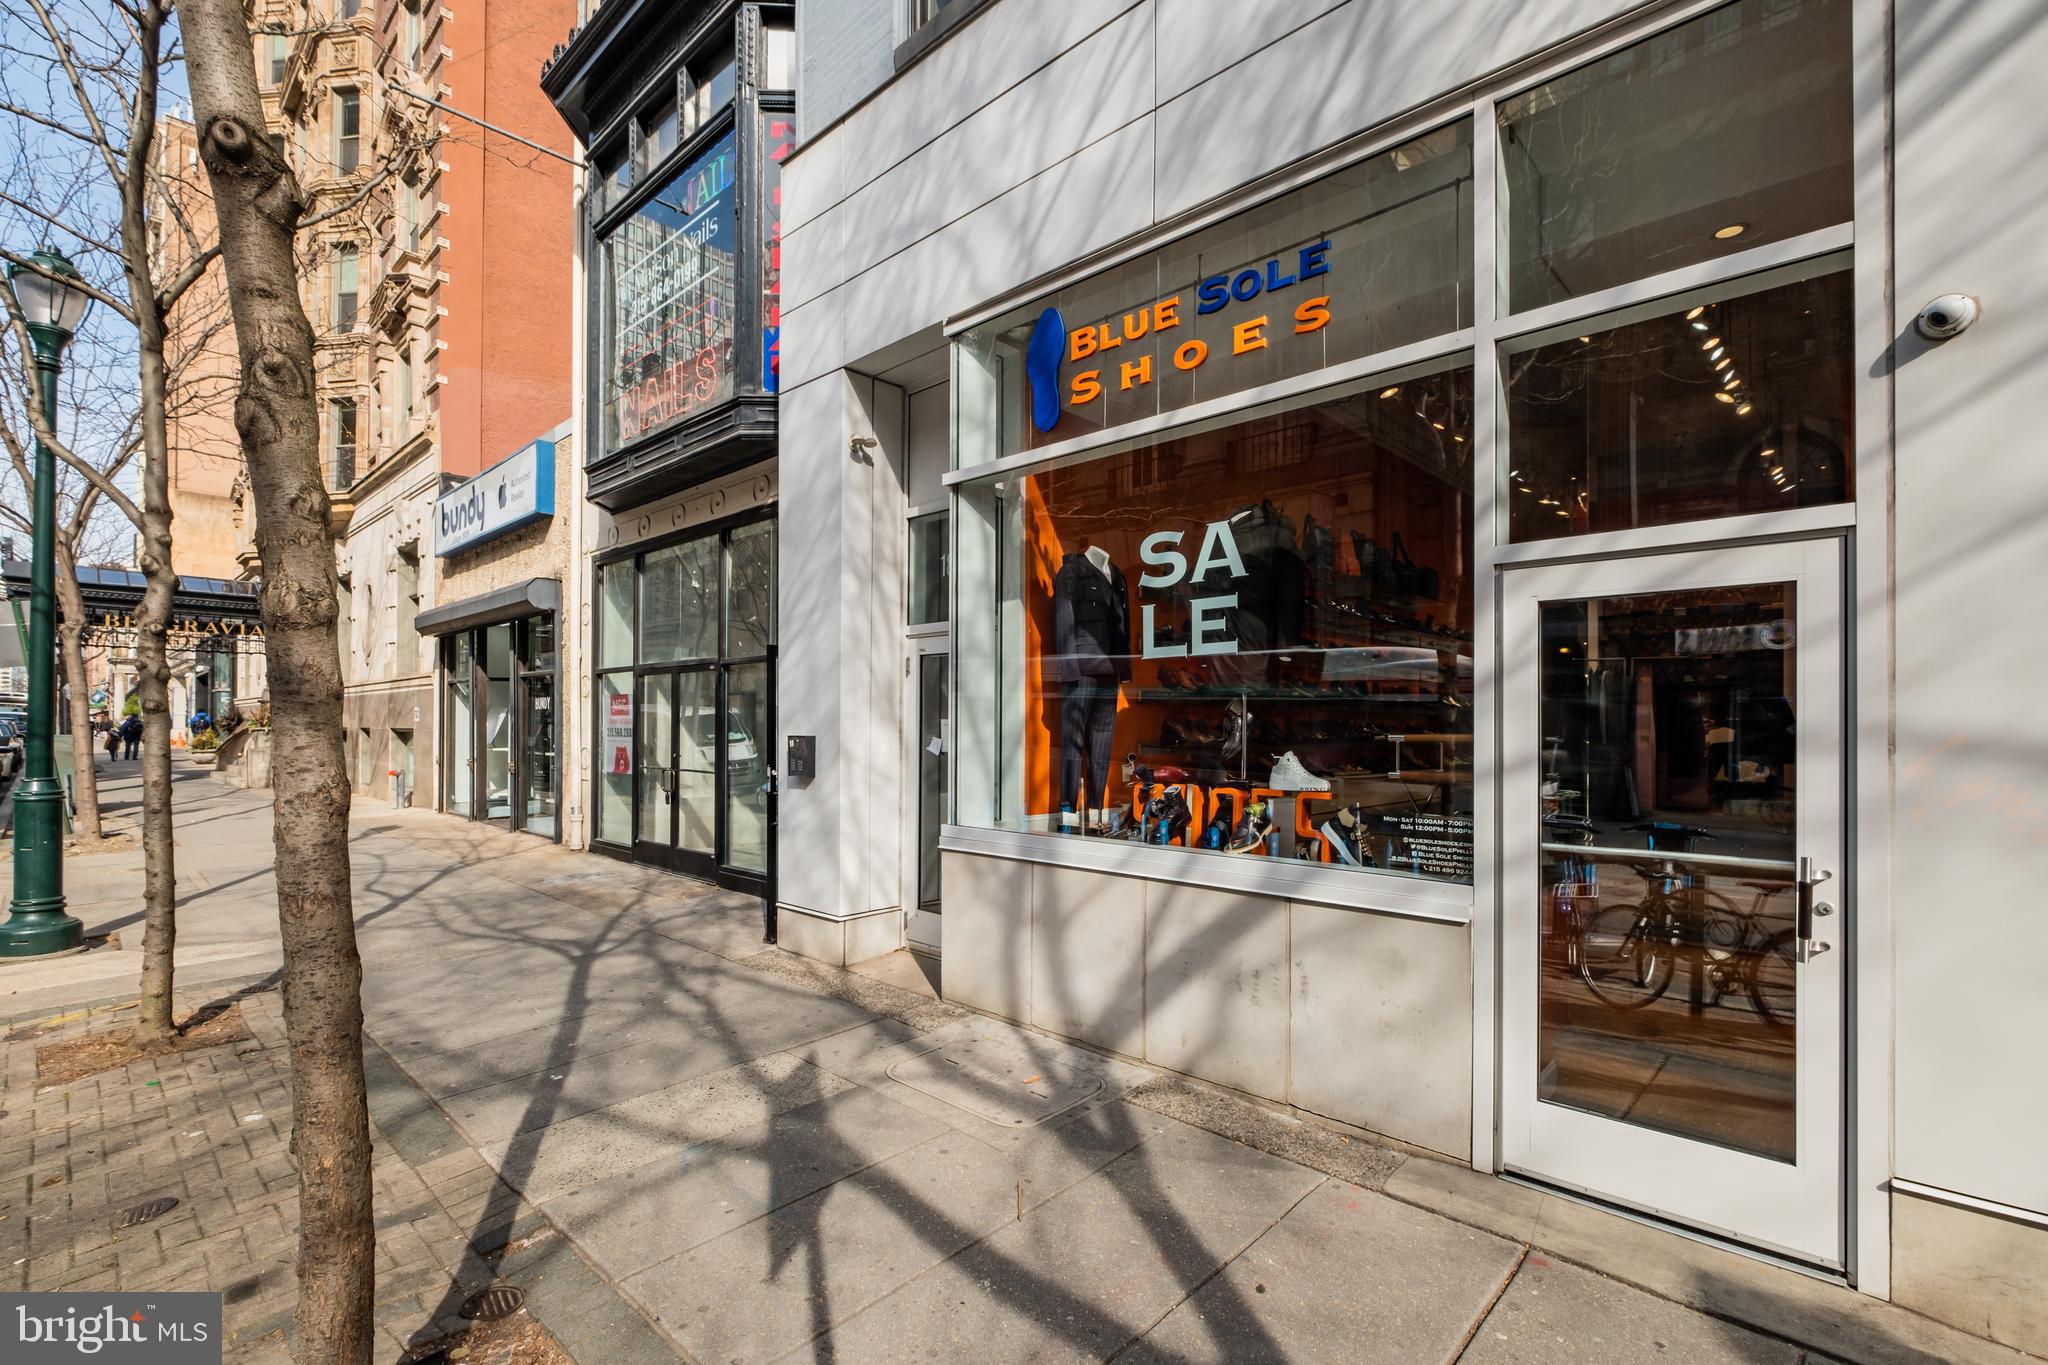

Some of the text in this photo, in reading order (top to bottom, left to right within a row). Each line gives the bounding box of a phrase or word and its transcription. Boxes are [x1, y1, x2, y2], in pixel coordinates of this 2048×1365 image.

[683, 217, 718, 258] Nails
[1070, 239, 1332, 362] BLUE SOLE
[1070, 295, 1331, 405] SHOES
[621, 346, 717, 440] NAILS
[441, 484, 485, 538] bundy
[1138, 520, 1250, 588] SA
[1141, 591, 1239, 660] LE
[534, 696, 551, 710] BUNDY
